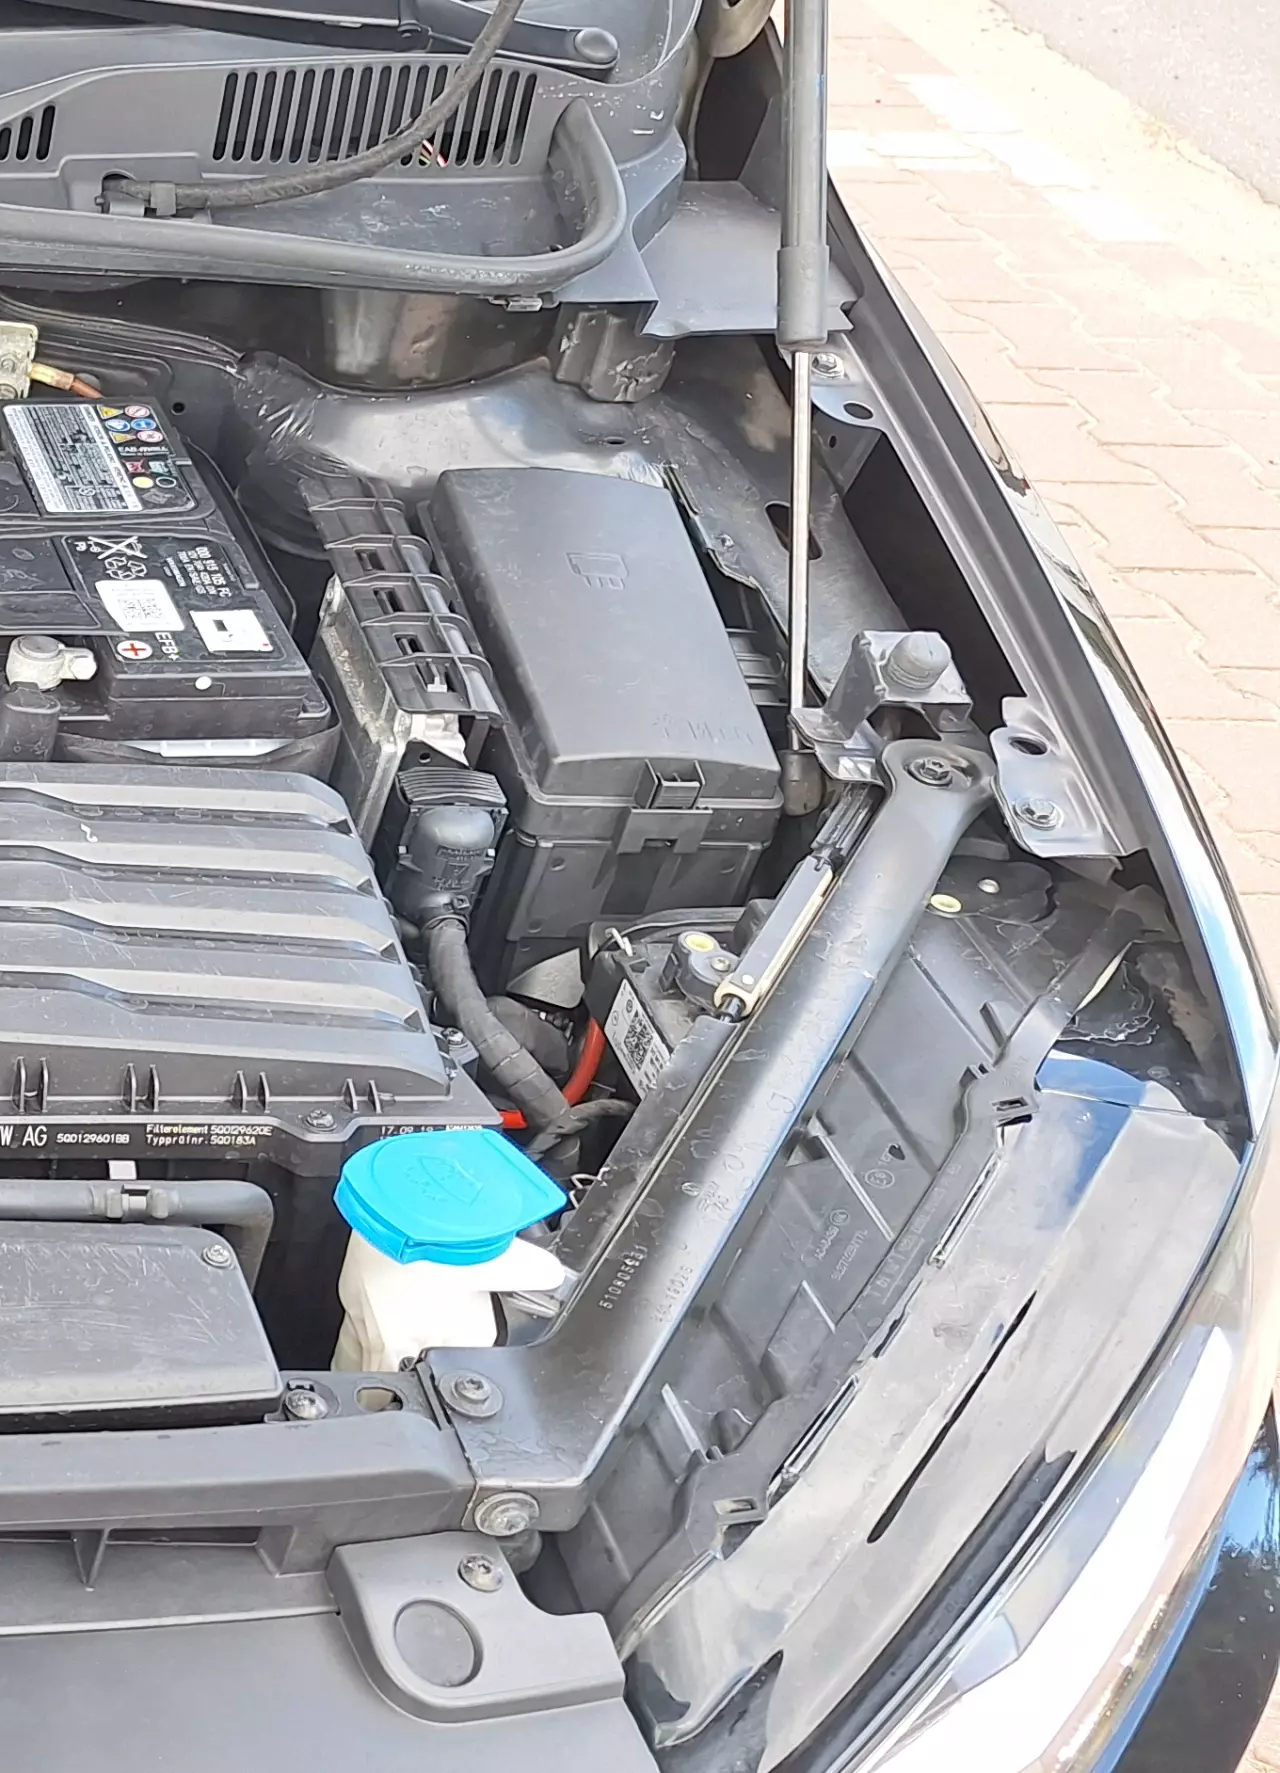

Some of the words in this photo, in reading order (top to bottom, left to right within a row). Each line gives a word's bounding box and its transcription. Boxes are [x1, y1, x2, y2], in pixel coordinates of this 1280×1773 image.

[217, 587, 232, 597] FC
[146, 1123, 208, 1134] Filterelement
[22, 1125, 47, 1147] AG
